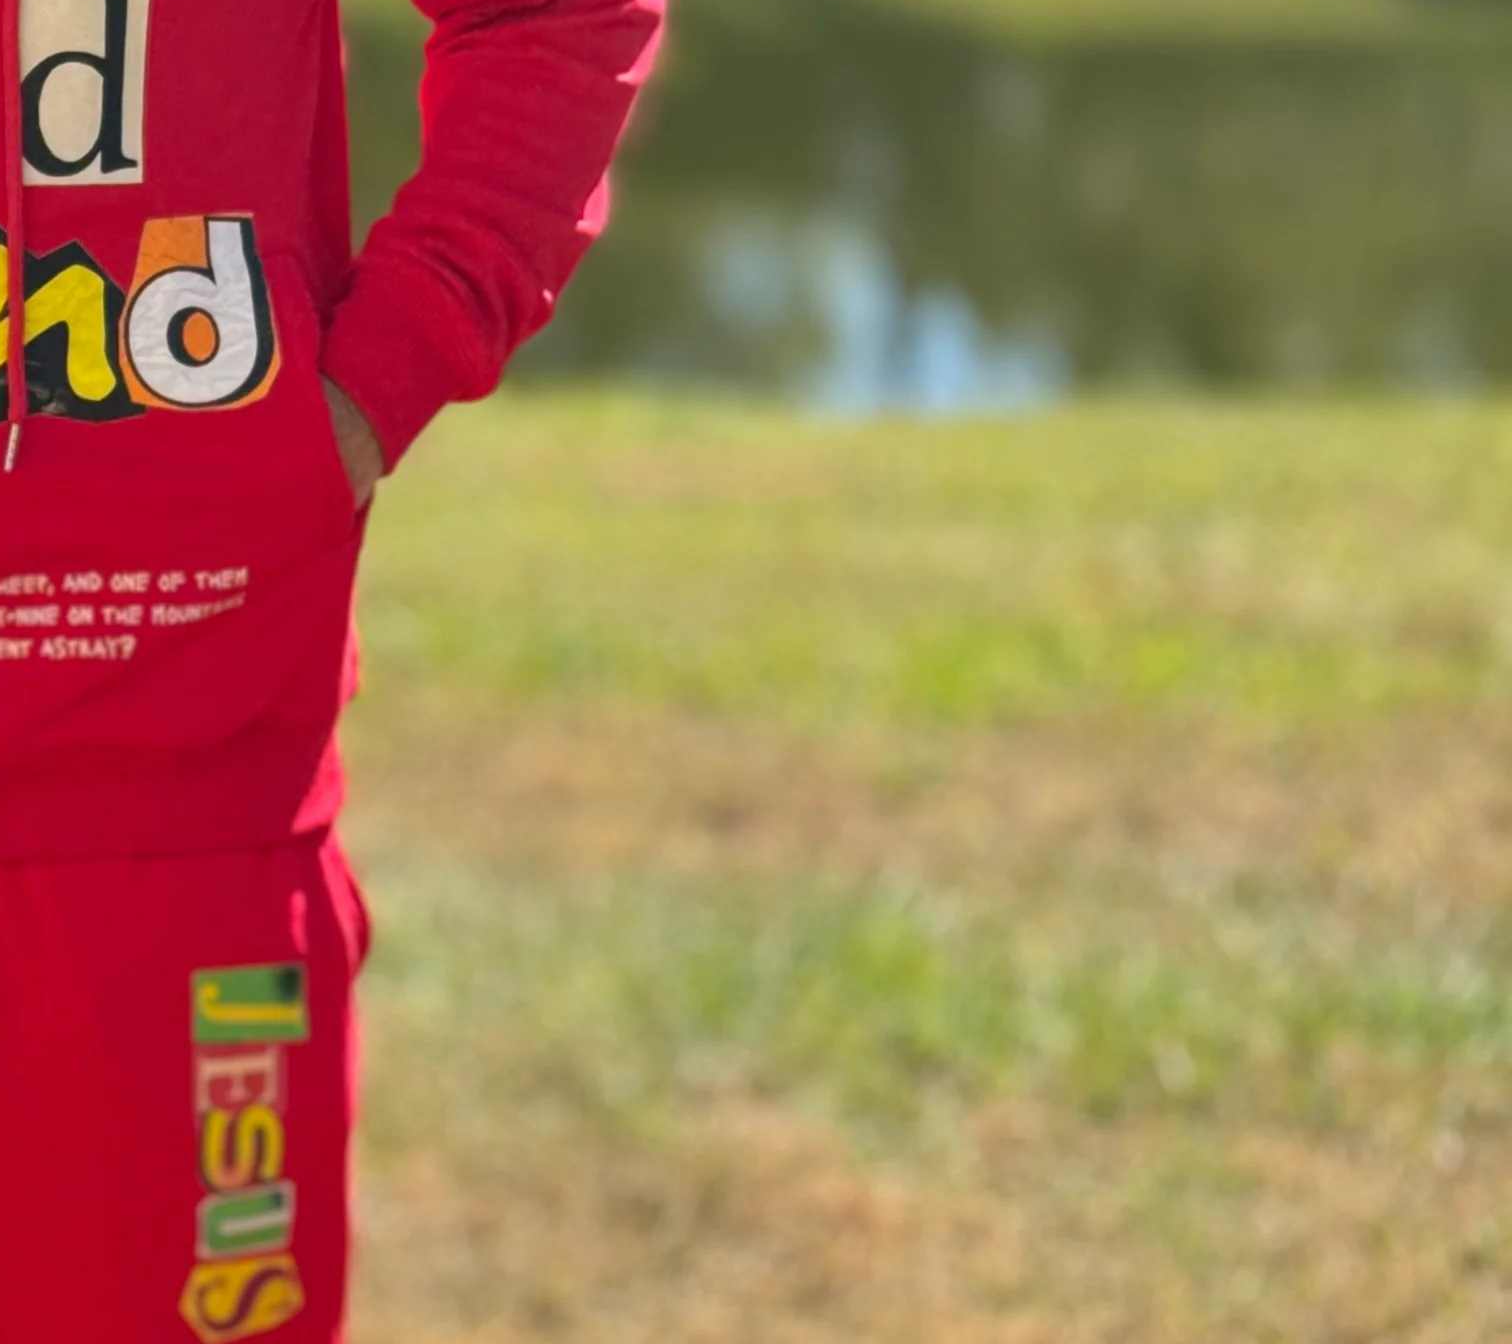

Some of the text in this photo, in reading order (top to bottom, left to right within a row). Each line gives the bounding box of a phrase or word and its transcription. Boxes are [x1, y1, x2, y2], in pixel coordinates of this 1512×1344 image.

[62, 571, 104, 593] AND
[109, 571, 151, 593] ONE
[157, 571, 186, 592] OF
[194, 566, 249, 590] THEM
[66, 605, 95, 626] ON
[101, 604, 143, 626] THE
[40, 634, 137, 660] ASTRAY?
